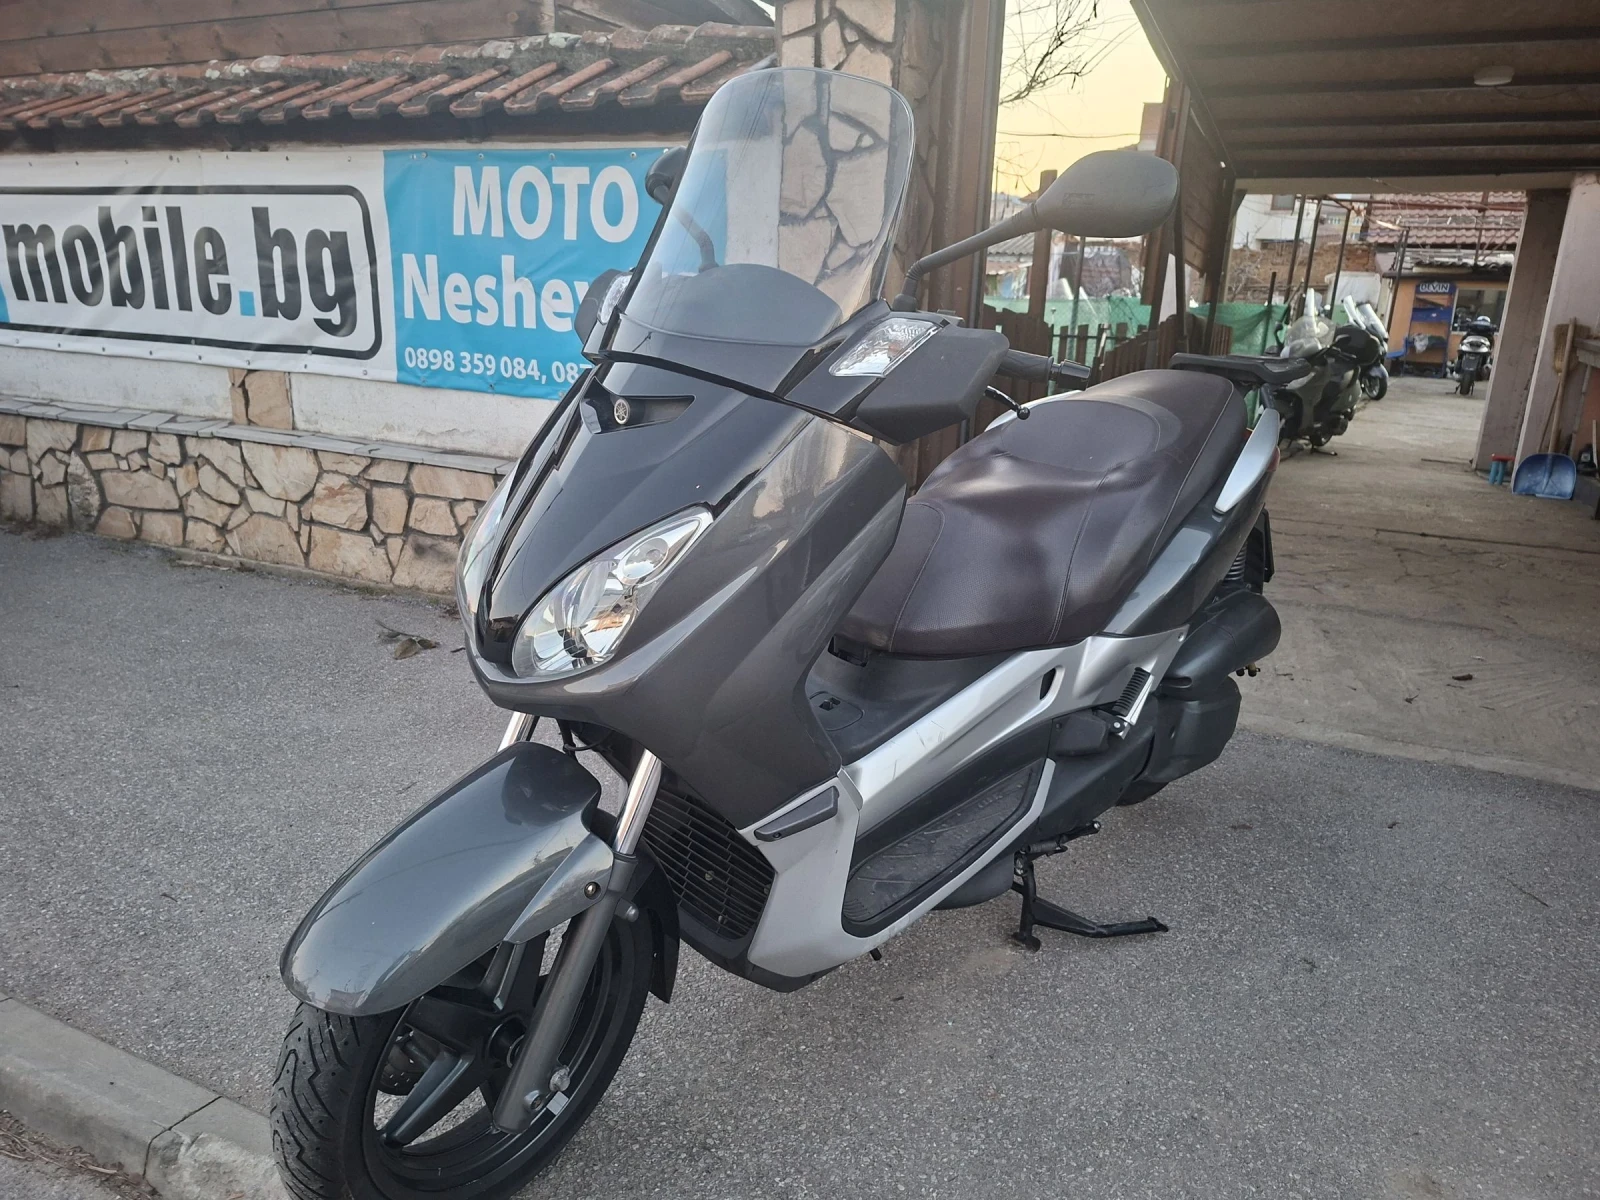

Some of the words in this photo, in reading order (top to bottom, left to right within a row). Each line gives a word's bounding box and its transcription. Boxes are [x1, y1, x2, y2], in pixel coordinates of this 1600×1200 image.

[453, 165, 639, 243] MOTO
[2, 205, 358, 338] mobile.bg
[402, 253, 590, 333] Neshe
[404, 346, 456, 372] 0898
[459, 351, 496, 376] 359
[500, 355, 547, 385] 084,
